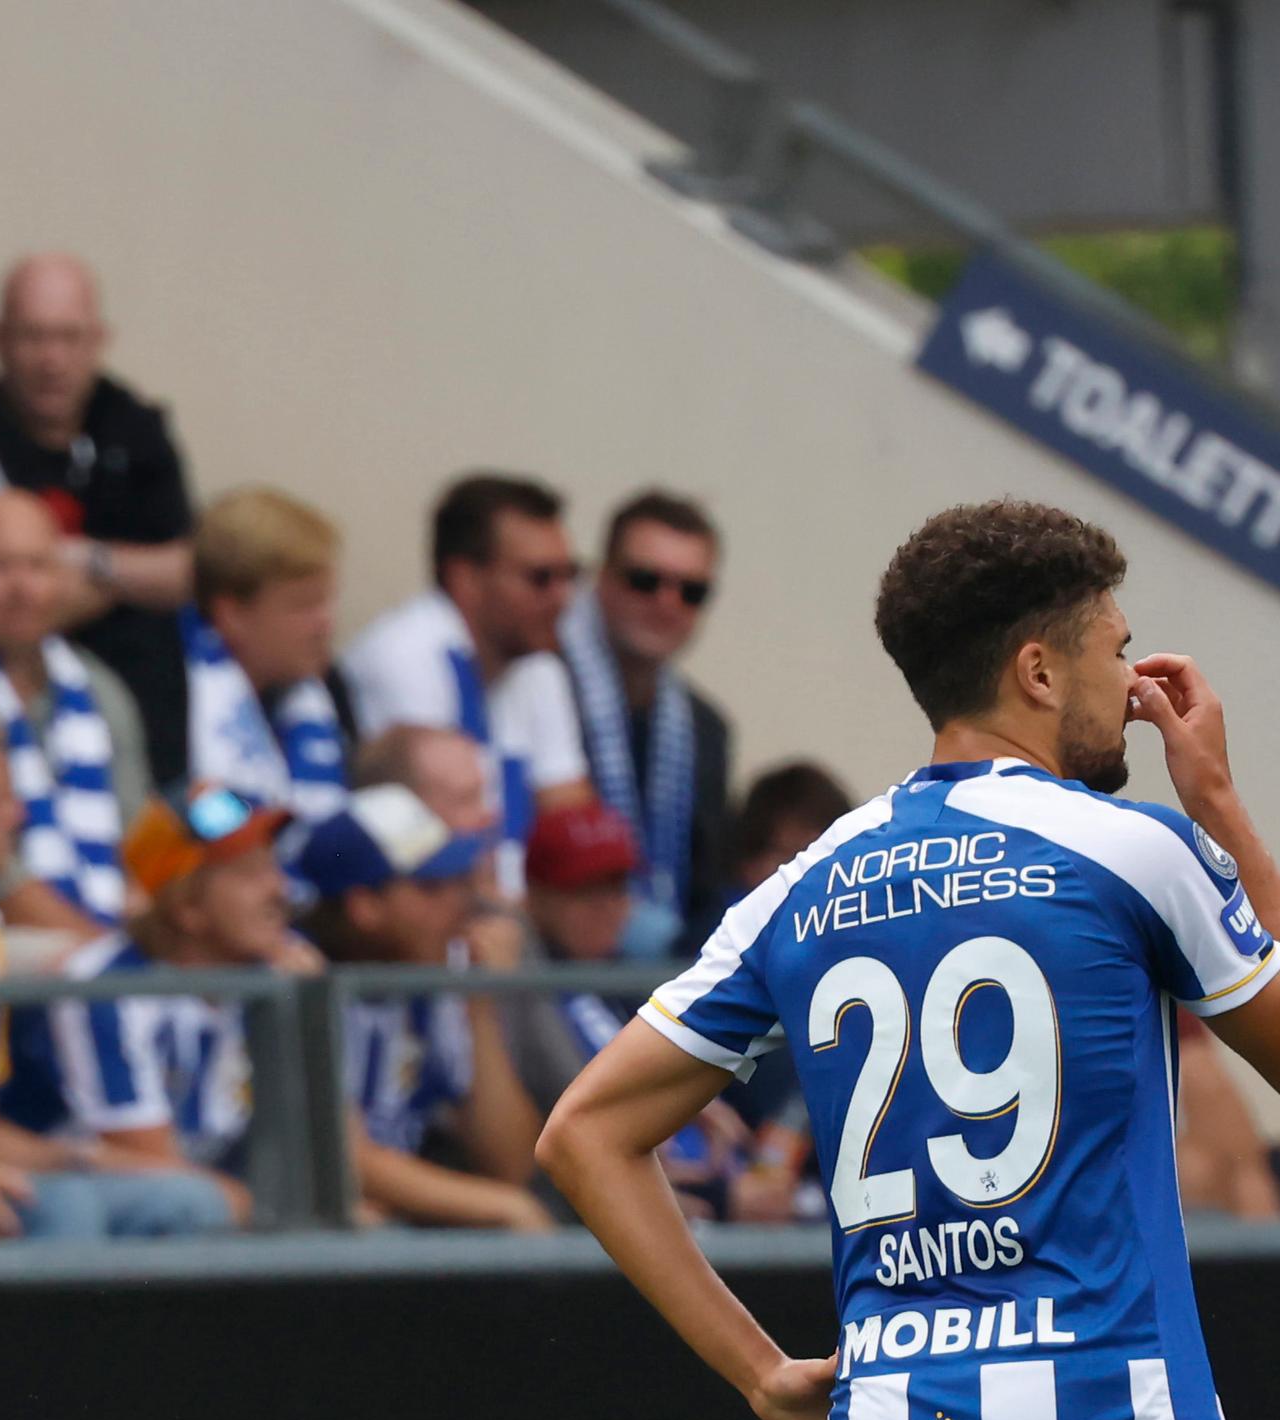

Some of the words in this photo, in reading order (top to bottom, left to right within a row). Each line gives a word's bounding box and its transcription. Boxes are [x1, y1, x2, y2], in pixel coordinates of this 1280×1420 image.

[826, 831, 1007, 896] NORDIC
[793, 865, 1056, 944] WELLNESS
[807, 935, 1062, 1232] 29
[875, 1216, 1024, 1287] SANTOS
[841, 1297, 1076, 1378] MOBILL
